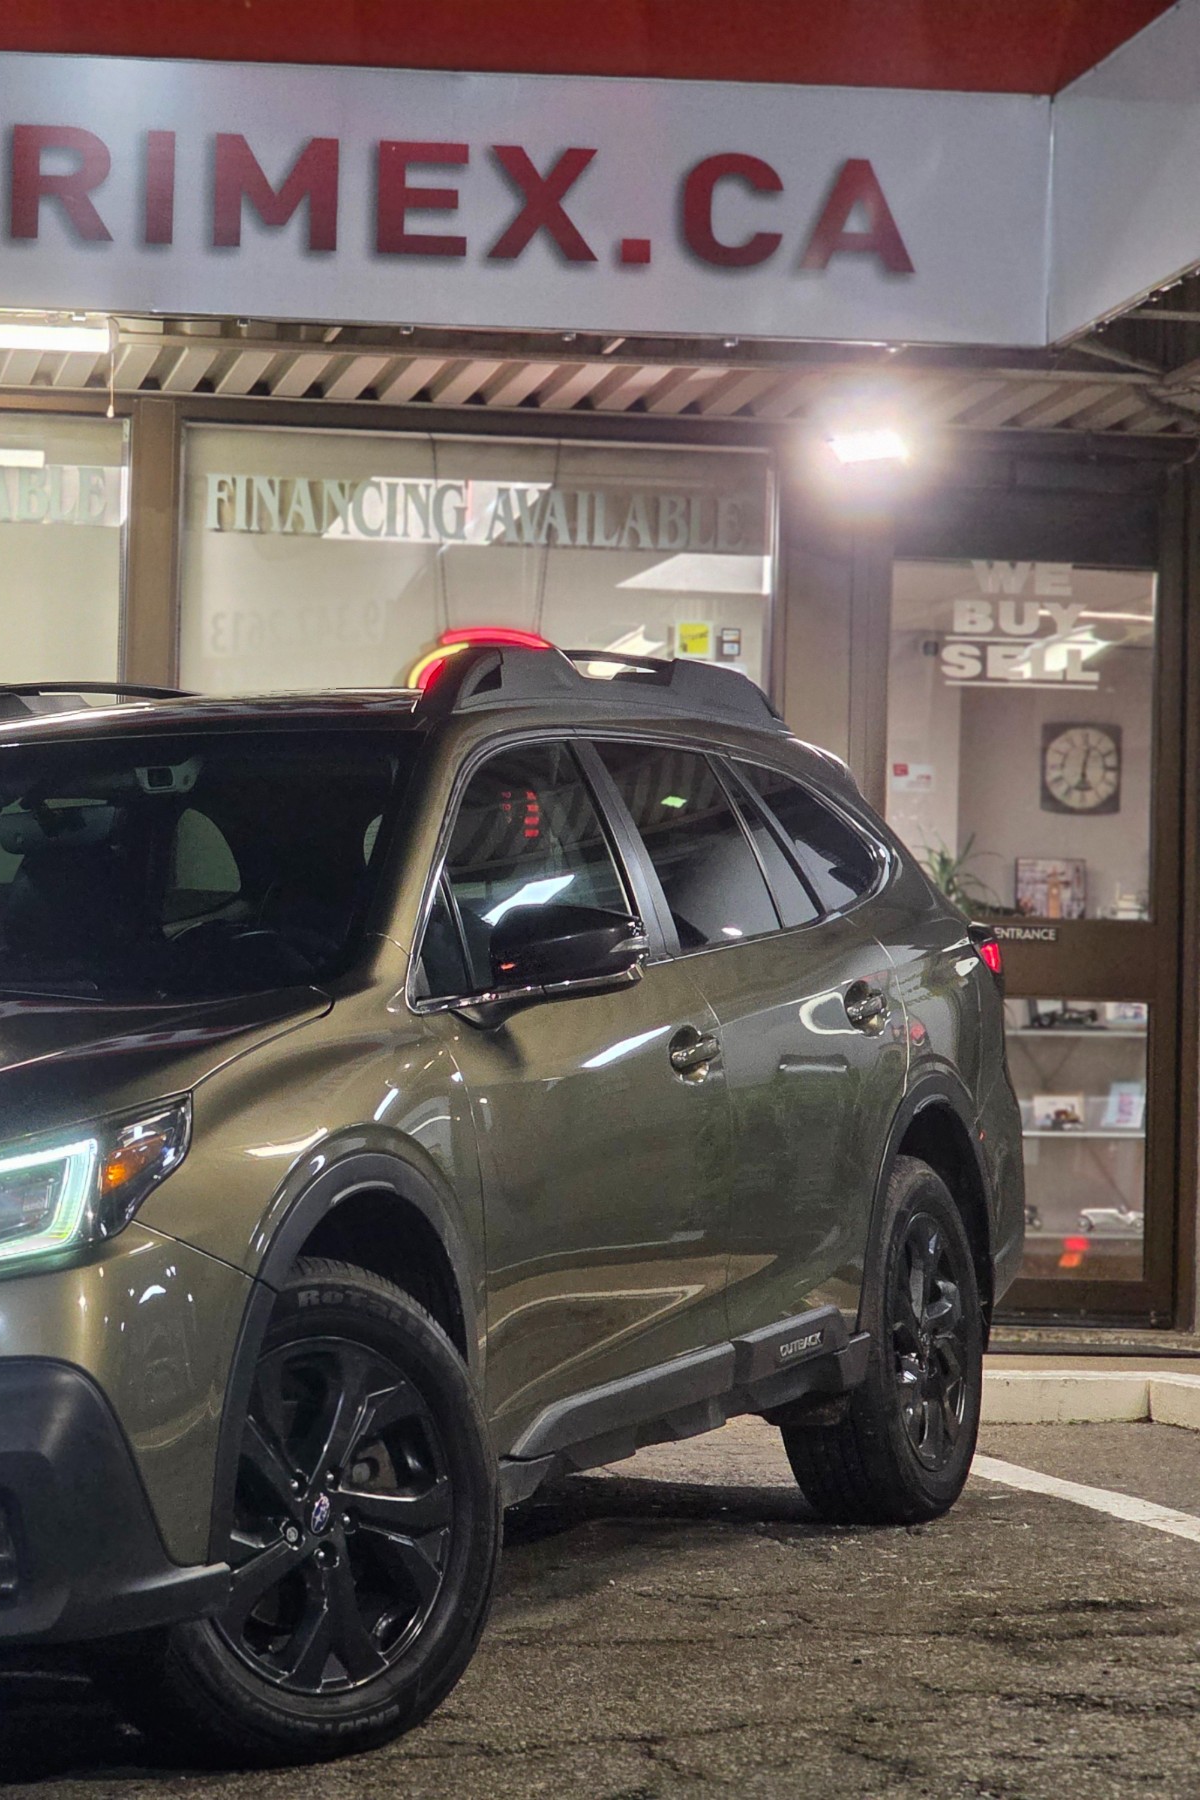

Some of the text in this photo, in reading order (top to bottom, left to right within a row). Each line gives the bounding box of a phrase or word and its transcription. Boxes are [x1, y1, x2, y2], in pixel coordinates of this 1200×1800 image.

[204, 473, 748, 550] FINANCING AVAILABLE
[972, 560, 1073, 596] WE
[953, 600, 1086, 636] BUY
[941, 644, 1100, 682] SELL
[993, 927, 1056, 941] ENTRANCE
[780, 1332, 822, 1357] OUTBACK
